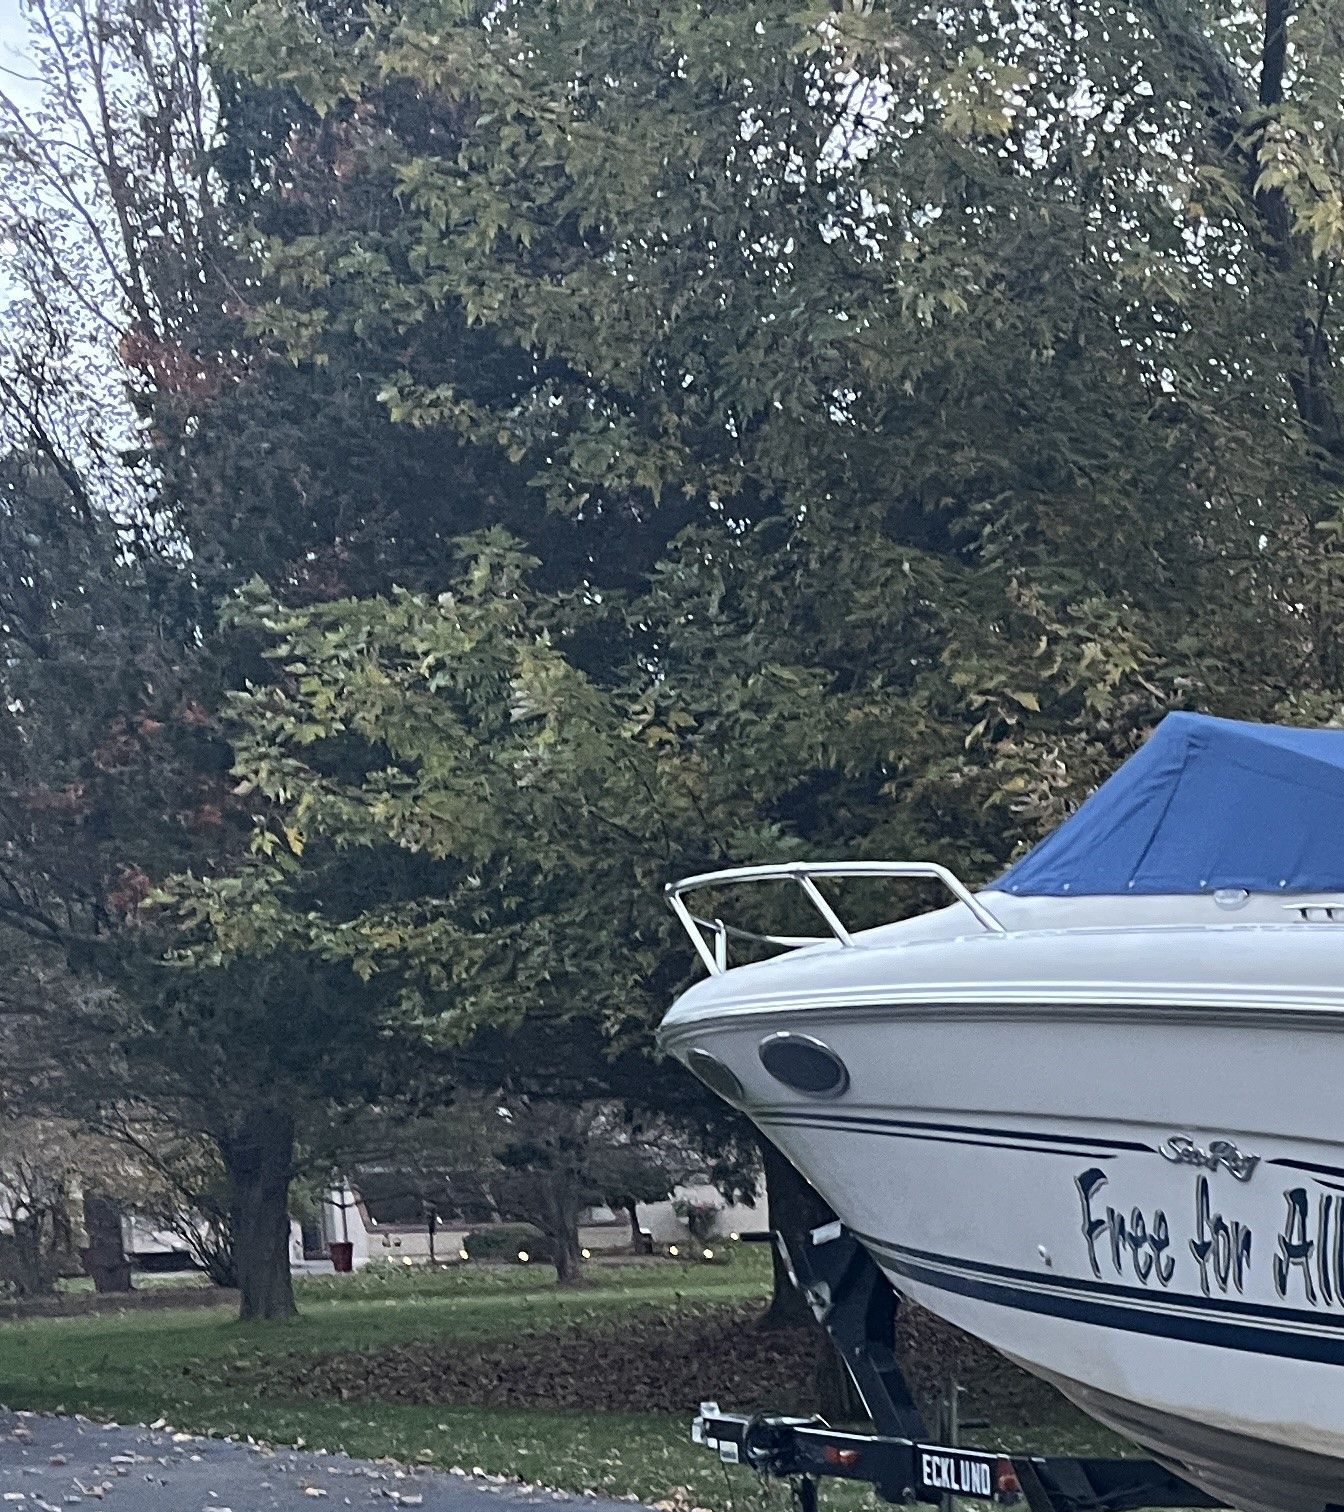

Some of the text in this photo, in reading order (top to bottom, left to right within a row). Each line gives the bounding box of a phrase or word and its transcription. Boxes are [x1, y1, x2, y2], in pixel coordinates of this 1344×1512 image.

[1073, 1167, 1175, 1288] Free
[1189, 1174, 1252, 1297] for
[922, 1453, 992, 1496] ECKLUND
